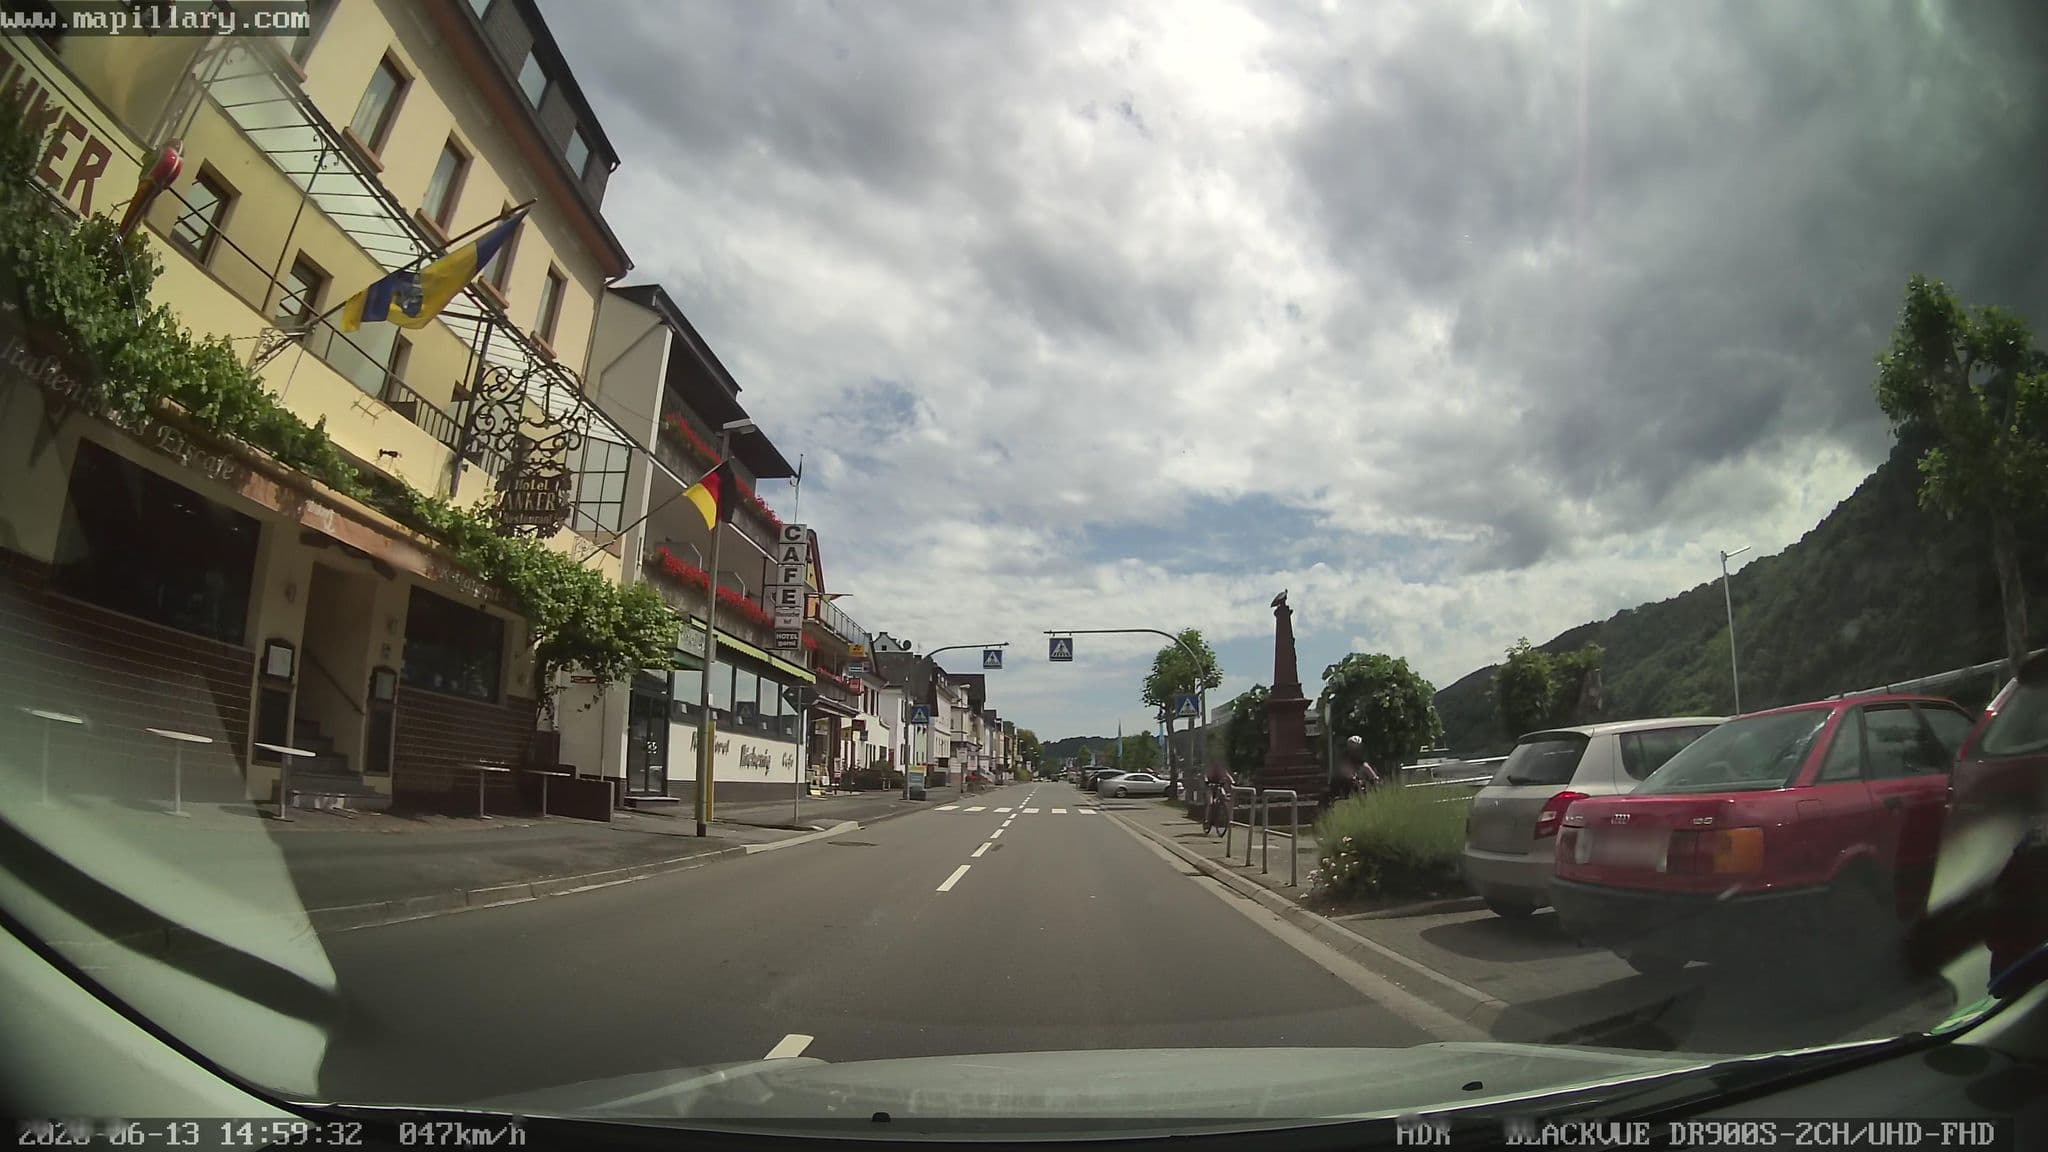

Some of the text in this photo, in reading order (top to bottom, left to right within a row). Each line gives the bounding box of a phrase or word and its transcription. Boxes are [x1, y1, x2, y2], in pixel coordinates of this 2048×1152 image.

[0, 42, 113, 218] NKER
[514, 479, 550, 491] Hotel
[782, 525, 801, 605] CAFE
